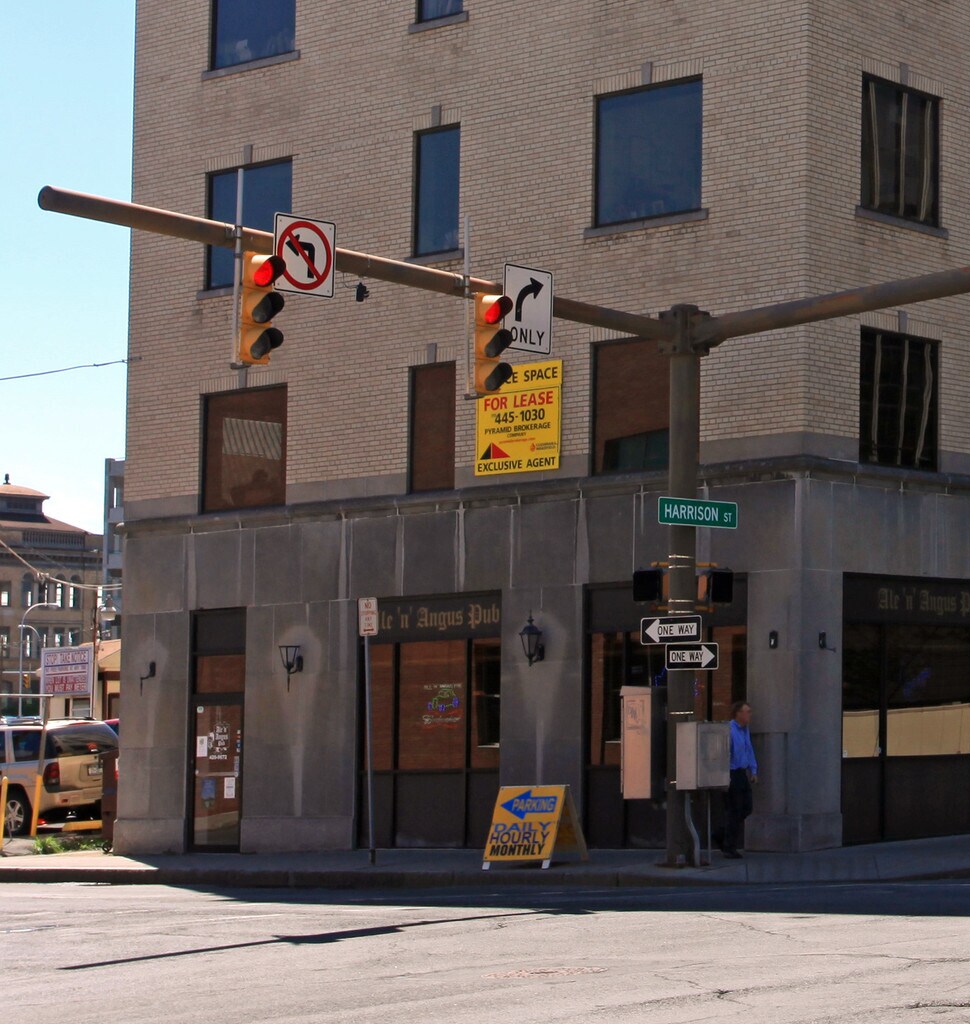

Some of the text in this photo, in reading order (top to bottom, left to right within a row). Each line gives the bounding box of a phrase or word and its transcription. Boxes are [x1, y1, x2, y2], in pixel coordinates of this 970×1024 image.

[511, 326, 545, 346] ONLY
[524, 367, 558, 382] SPACE
[484, 391, 554, 411] FOR LEASE
[494, 408, 545, 424] 445-1030
[484, 422, 551, 435] PYRAMID BROKERAGE
[477, 457, 556, 473] EXCLUSIVE AGENT
[664, 503, 732, 523] HARRISON ST
[919, 589, 957, 616] Angus
[416, 607, 464, 631] Angus
[468, 603, 500, 629] Pub
[657, 624, 695, 635] ONE WAY
[71, 651, 88, 662] NOTICE
[671, 652, 704, 662] ONE WAY
[511, 797, 555, 812] PARKING
[494, 822, 552, 833] DAILY
[489, 831, 549, 844] HOURLY
[489, 844, 545, 856] MONTHLY
